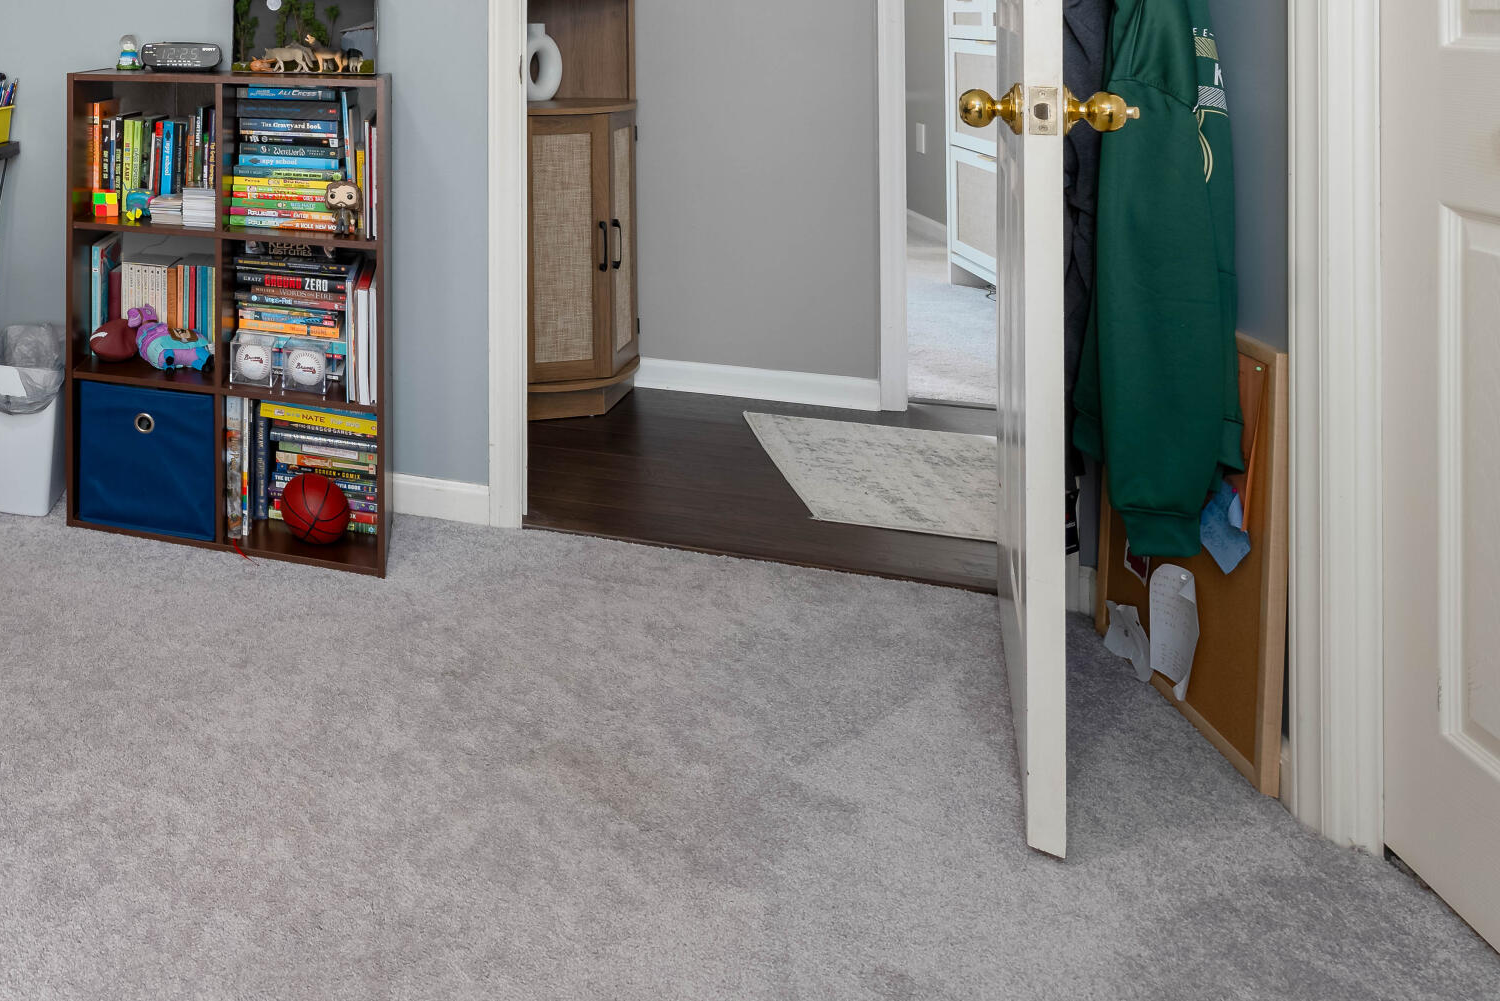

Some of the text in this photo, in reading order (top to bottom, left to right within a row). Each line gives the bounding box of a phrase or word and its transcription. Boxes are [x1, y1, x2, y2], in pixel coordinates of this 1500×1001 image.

[289, 249, 312, 257] CITIES
[264, 274, 328, 292] GROUND ZERO
[279, 288, 307, 298] WORDS
[315, 292, 333, 300] FIRE
[301, 414, 325, 423] NATE
[314, 468, 336, 477] SCREEN
